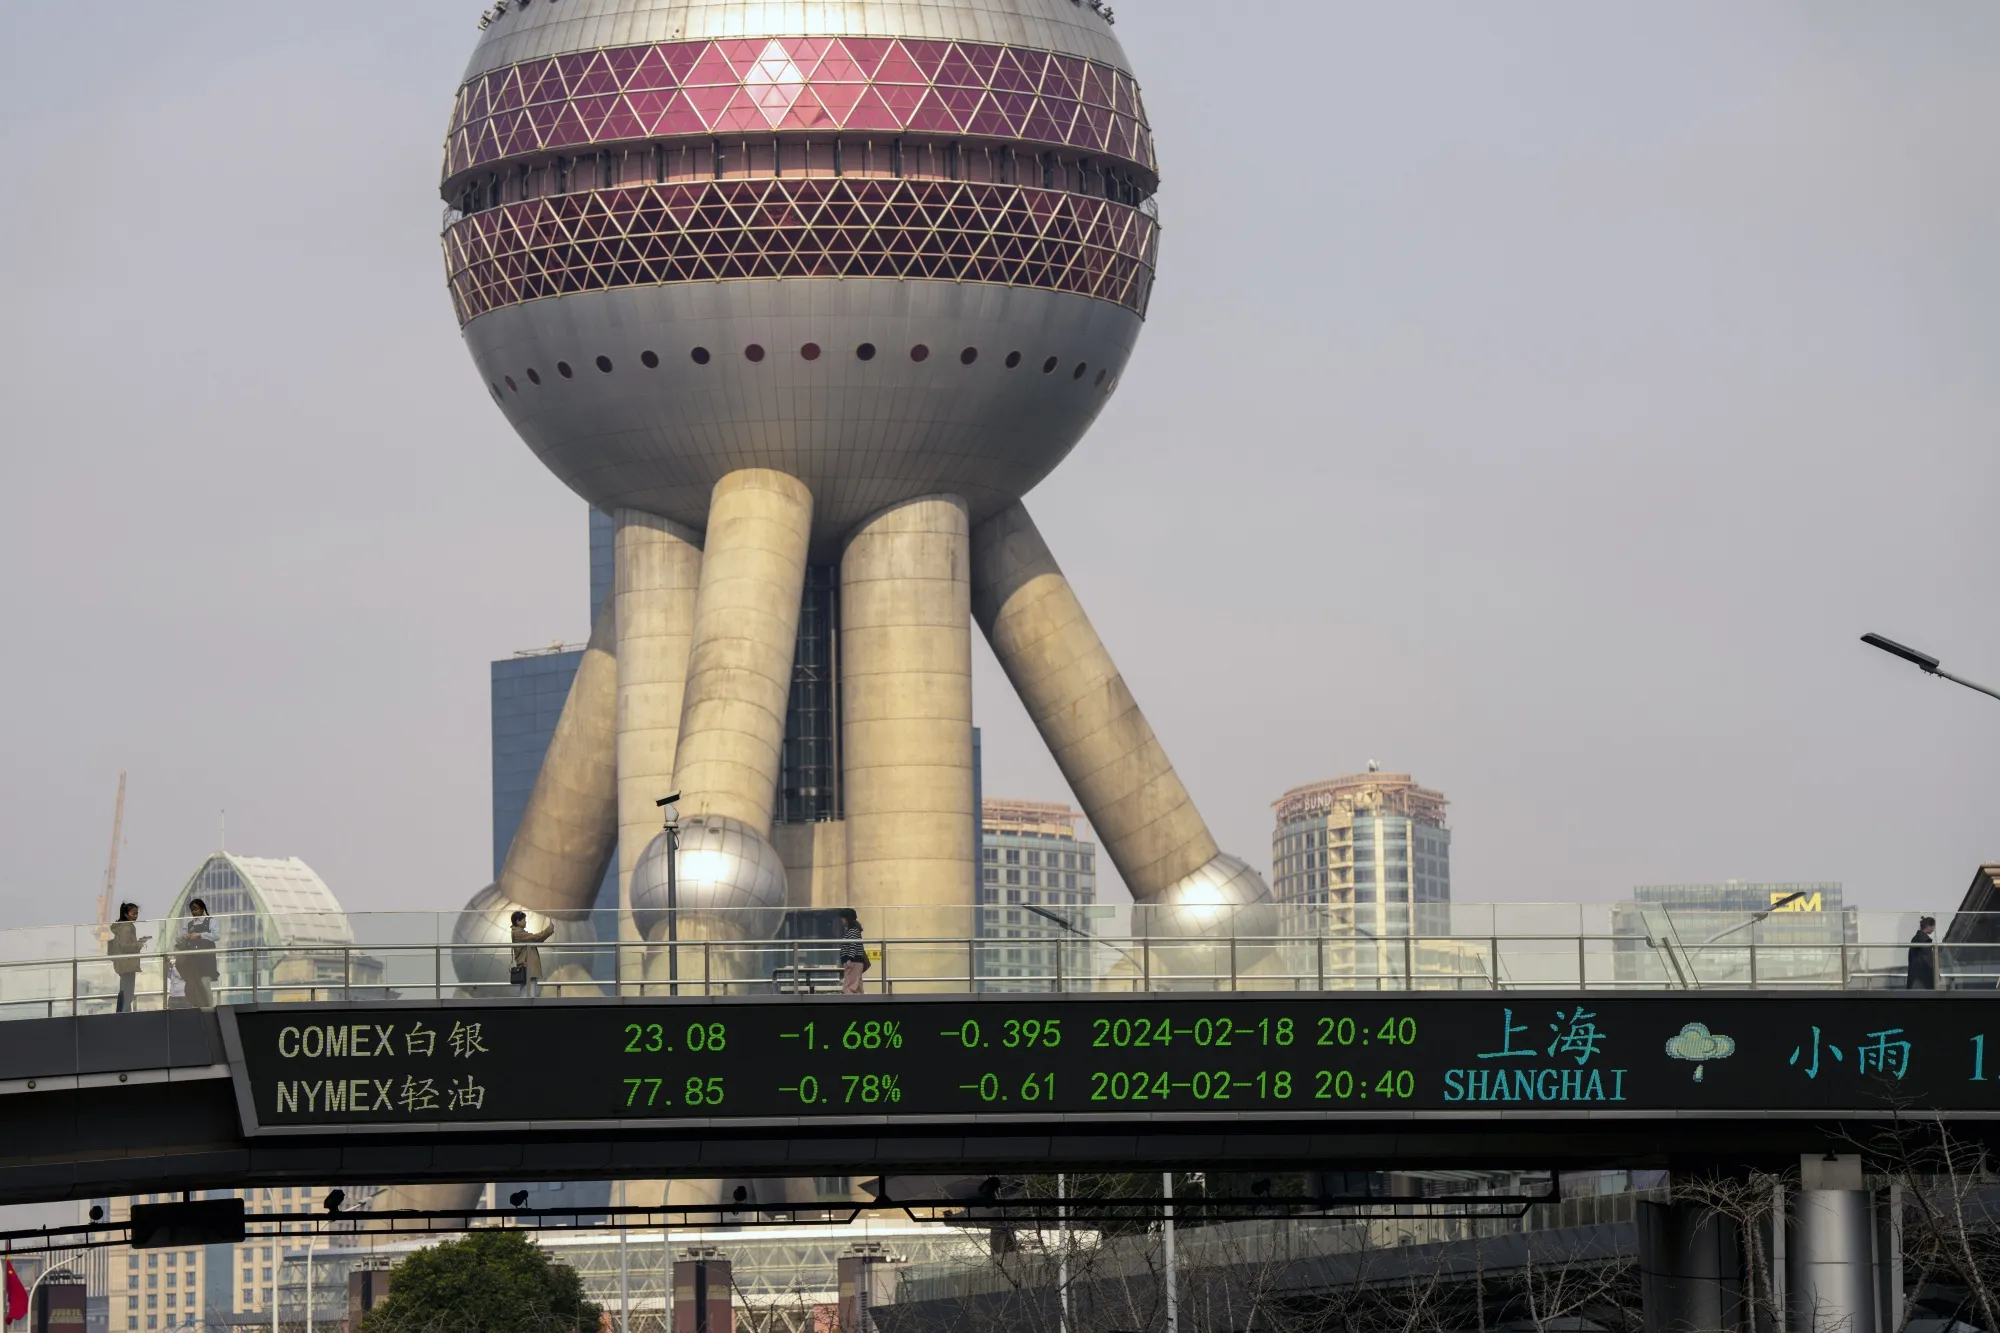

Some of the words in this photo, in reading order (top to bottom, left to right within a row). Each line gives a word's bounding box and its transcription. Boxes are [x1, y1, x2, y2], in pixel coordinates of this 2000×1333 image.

[1304, 793, 1331, 811] BUND
[625, 1023, 725, 1052] 23.08
[1093, 1018, 1293, 1047] 2024-02-18
[1317, 1017, 1416, 1045] 20:40
[1477, 1007, 1606, 1065] 上海
[1790, 1026, 1911, 1079] 小雨
[624, 1077, 724, 1106] 77.85
[1091, 1071, 1291, 1100] 2024-02-18
[1315, 1070, 1414, 1098] 20:40
[1444, 1069, 1627, 1101] SHANGHAI
